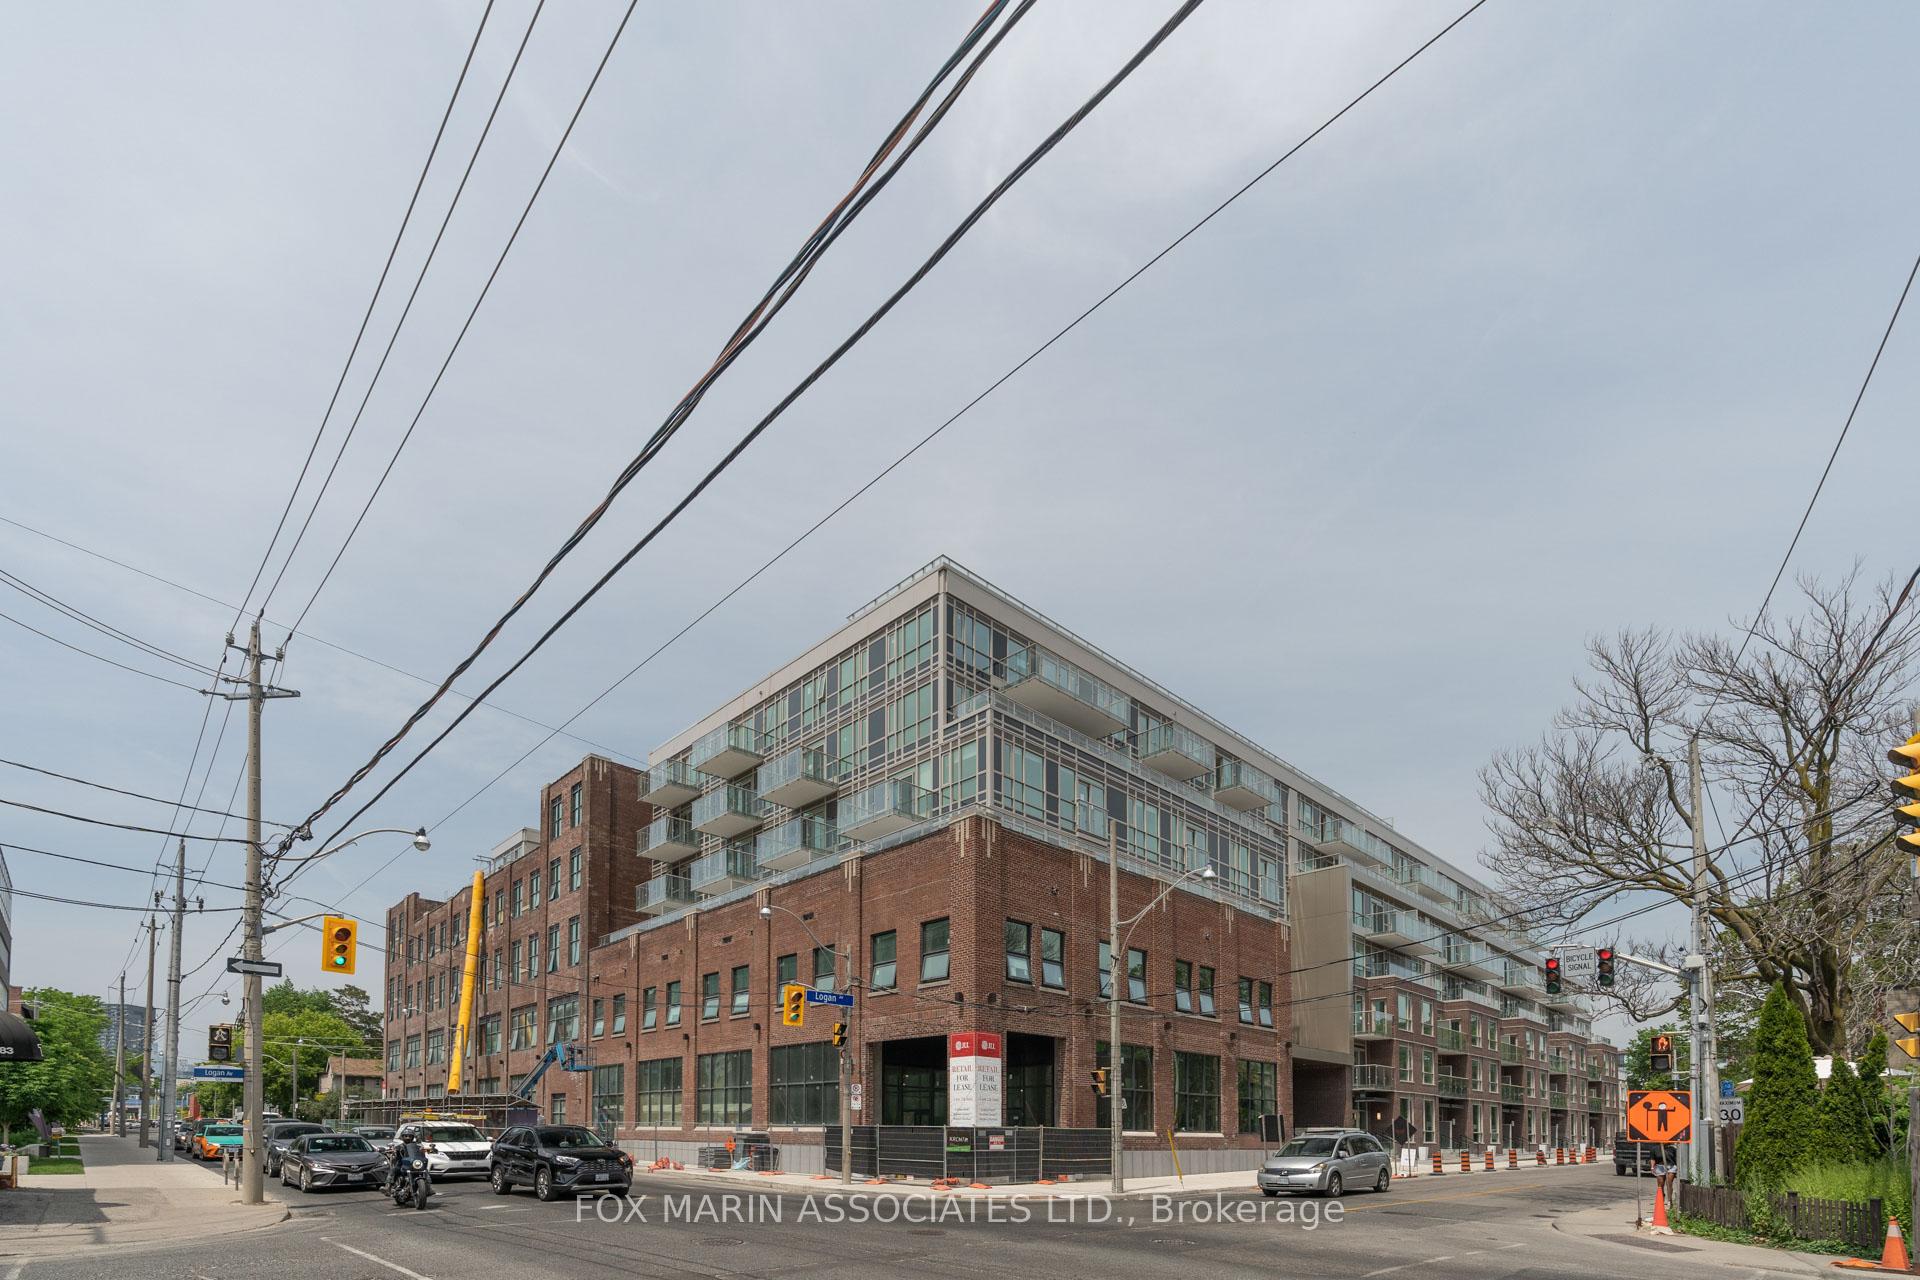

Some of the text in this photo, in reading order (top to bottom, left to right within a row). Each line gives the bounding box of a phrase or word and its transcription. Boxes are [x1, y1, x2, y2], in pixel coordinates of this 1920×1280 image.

[1566, 953, 1593, 962] BICYCLE
[1568, 962, 1591, 971] SIGNAL
[815, 991, 837, 1003] Logan
[204, 1069, 226, 1077] Logan
[951, 1065, 973, 1073] RETAIL
[976, 1065, 999, 1073] RETAIL
[956, 1074, 969, 1082] FOR
[982, 1074, 995, 1082] FOR
[953, 1083, 973, 1091] LEASE
[979, 1084, 999, 1092] LEASE
[1720, 1109, 1741, 1121] 30
